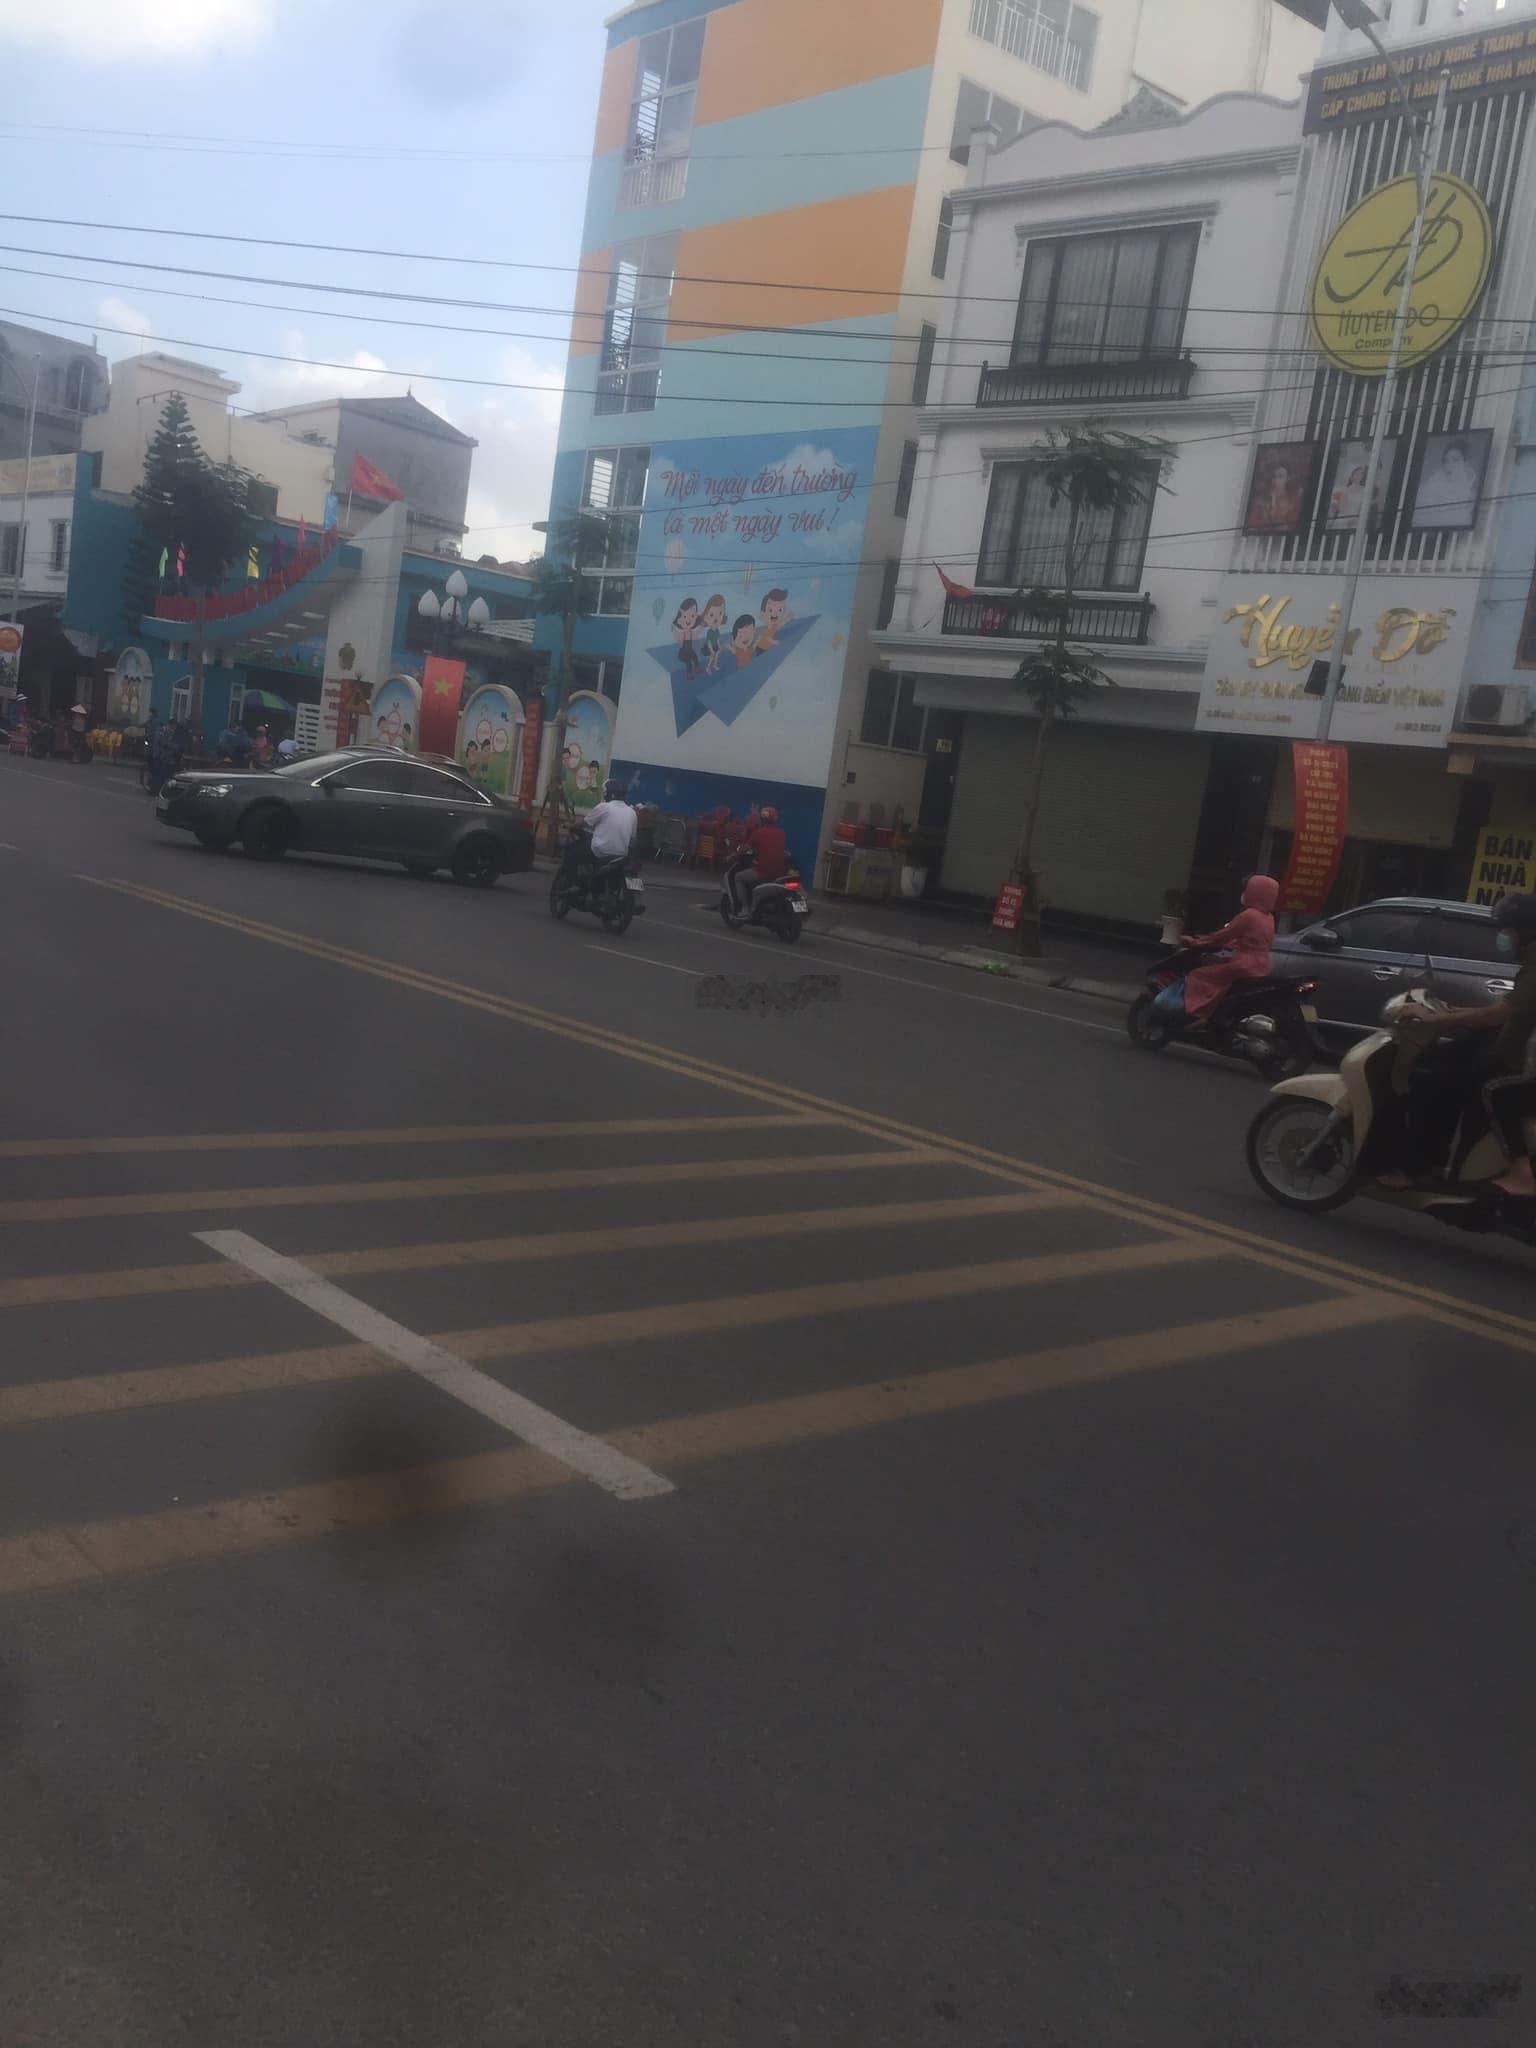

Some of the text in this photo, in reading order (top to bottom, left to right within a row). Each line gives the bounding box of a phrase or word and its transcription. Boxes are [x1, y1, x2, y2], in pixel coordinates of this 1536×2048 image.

[1354, 335, 1413, 350] Compny
[705, 467, 749, 506] ngày
[752, 463, 787, 495] đến
[791, 462, 858, 503] trường
[689, 509, 729, 539] một
[735, 507, 783, 543] ngày
[1485, 832, 1533, 860] BÁN
[1479, 861, 1526, 887] NHÀ
